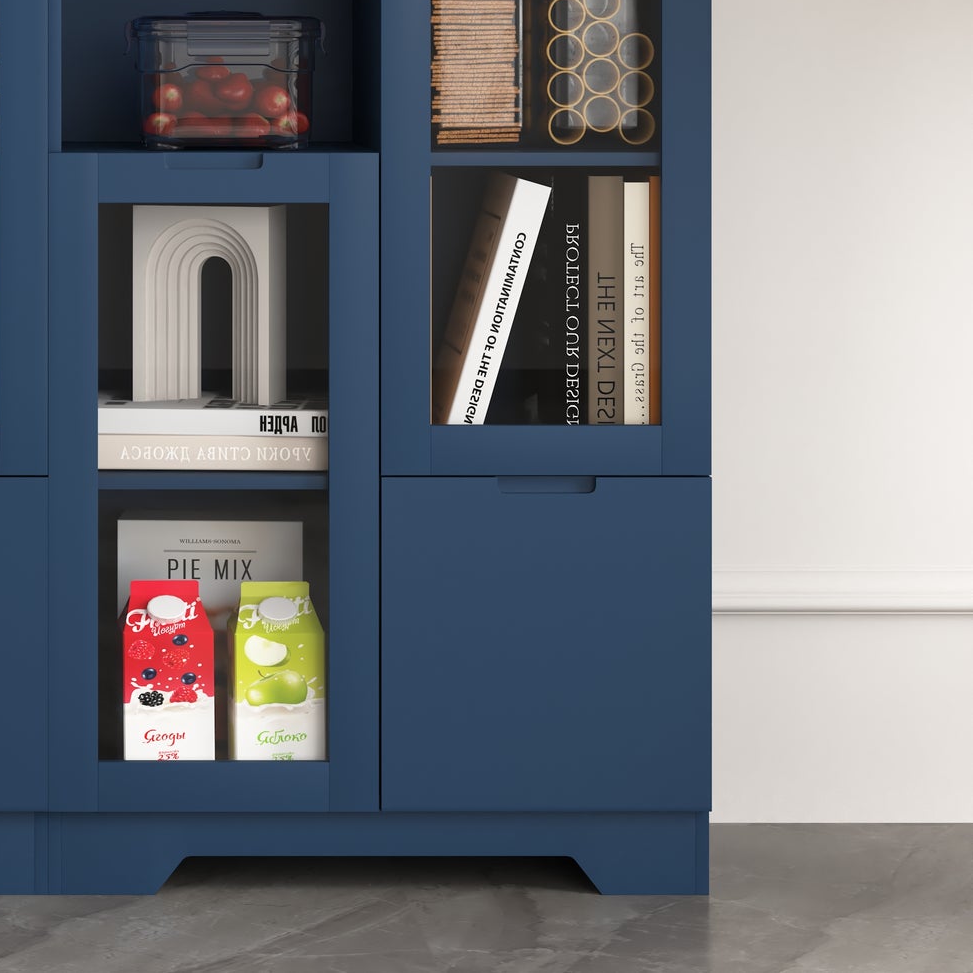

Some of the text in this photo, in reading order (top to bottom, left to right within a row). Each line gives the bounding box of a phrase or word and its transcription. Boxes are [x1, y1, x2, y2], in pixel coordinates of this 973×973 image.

[167, 558, 253, 581] PIE MIX
[142, 729, 186, 746] Ягоды
[255, 729, 308, 746] Яблоко
